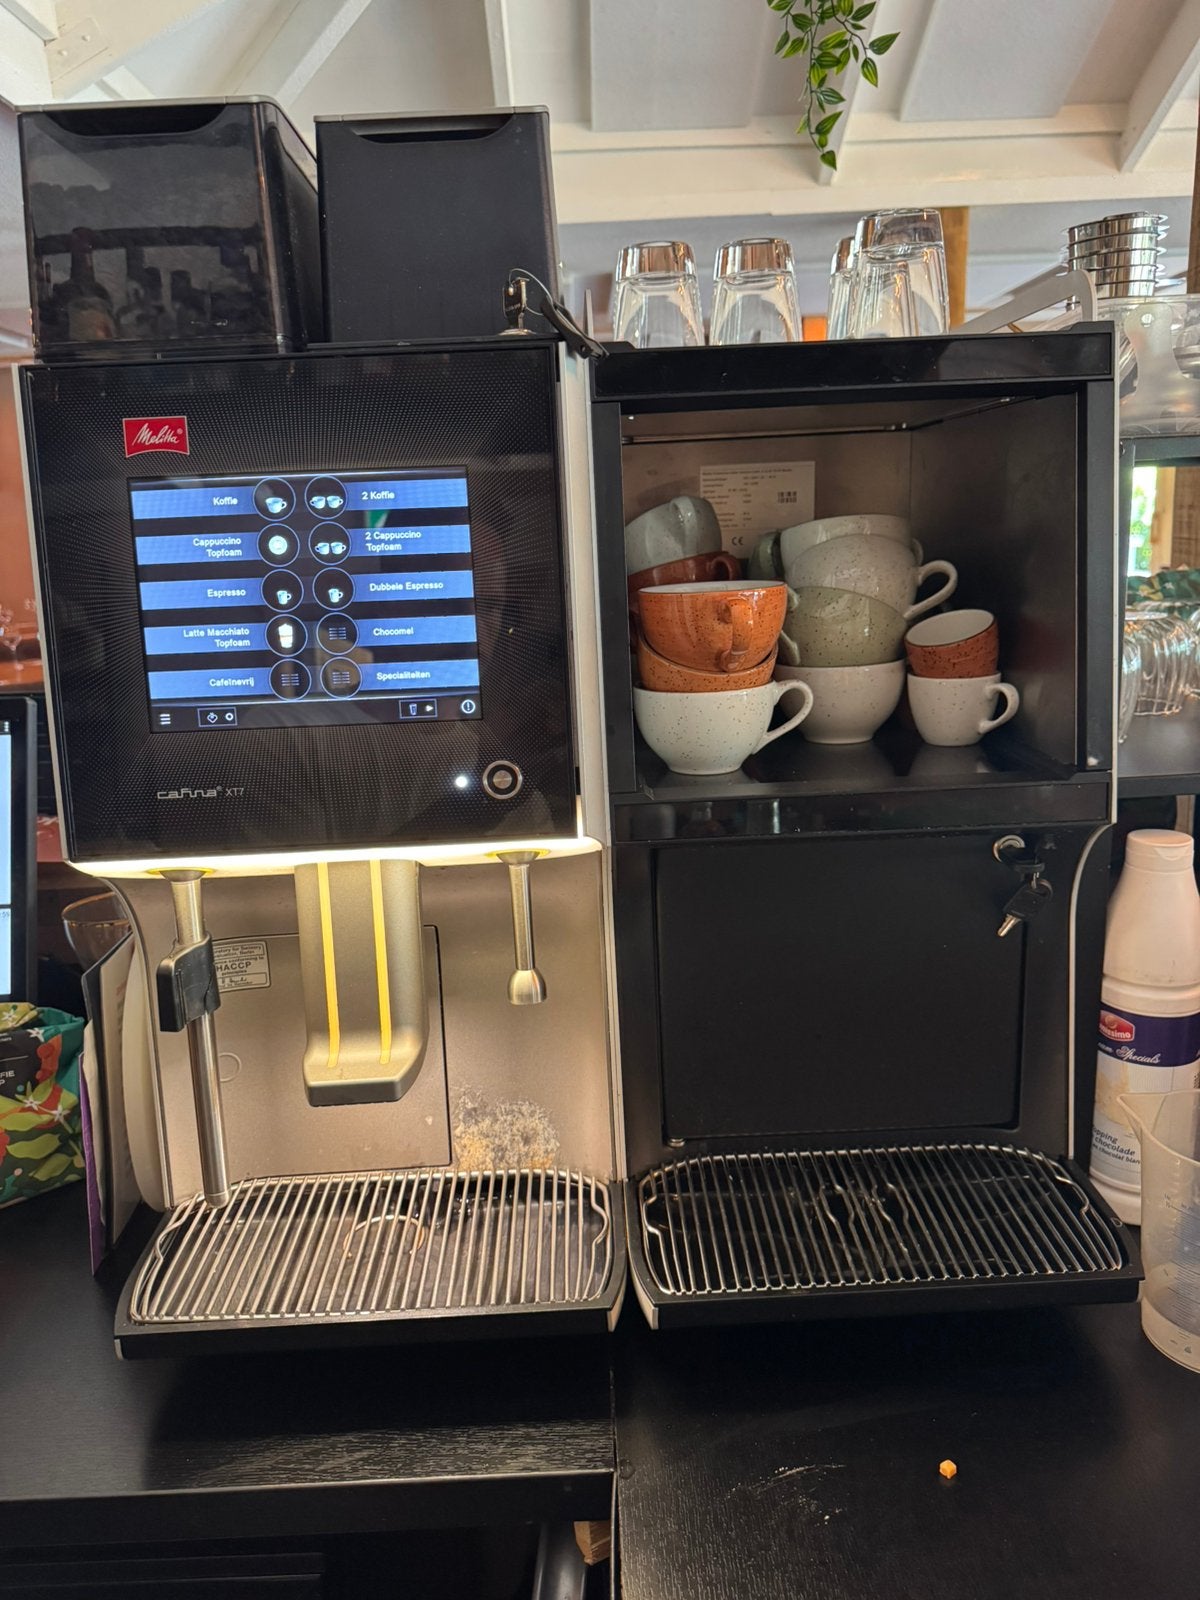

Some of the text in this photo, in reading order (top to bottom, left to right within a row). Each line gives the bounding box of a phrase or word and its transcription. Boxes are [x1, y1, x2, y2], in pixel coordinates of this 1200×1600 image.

[361, 490, 395, 500] 2 Koffie
[213, 496, 238, 506] Koffie
[365, 530, 421, 541] 2 Cappuccino
[193, 536, 241, 547] Cappuccino
[207, 548, 242, 558] Topfoam
[366, 542, 402, 553] Topfoam
[369, 580, 443, 592] Dubbele Espresso
[207, 587, 246, 598] Espresso
[183, 626, 249, 638] Latte Macchiato
[373, 627, 414, 637] Chocomel
[215, 638, 250, 649] Topfoam
[377, 670, 430, 681] Specialiteiten
[225, 787, 244, 797] XT7
[216, 961, 251, 971] HACCP
[1116, 1046, 1161, 1064] Specials
